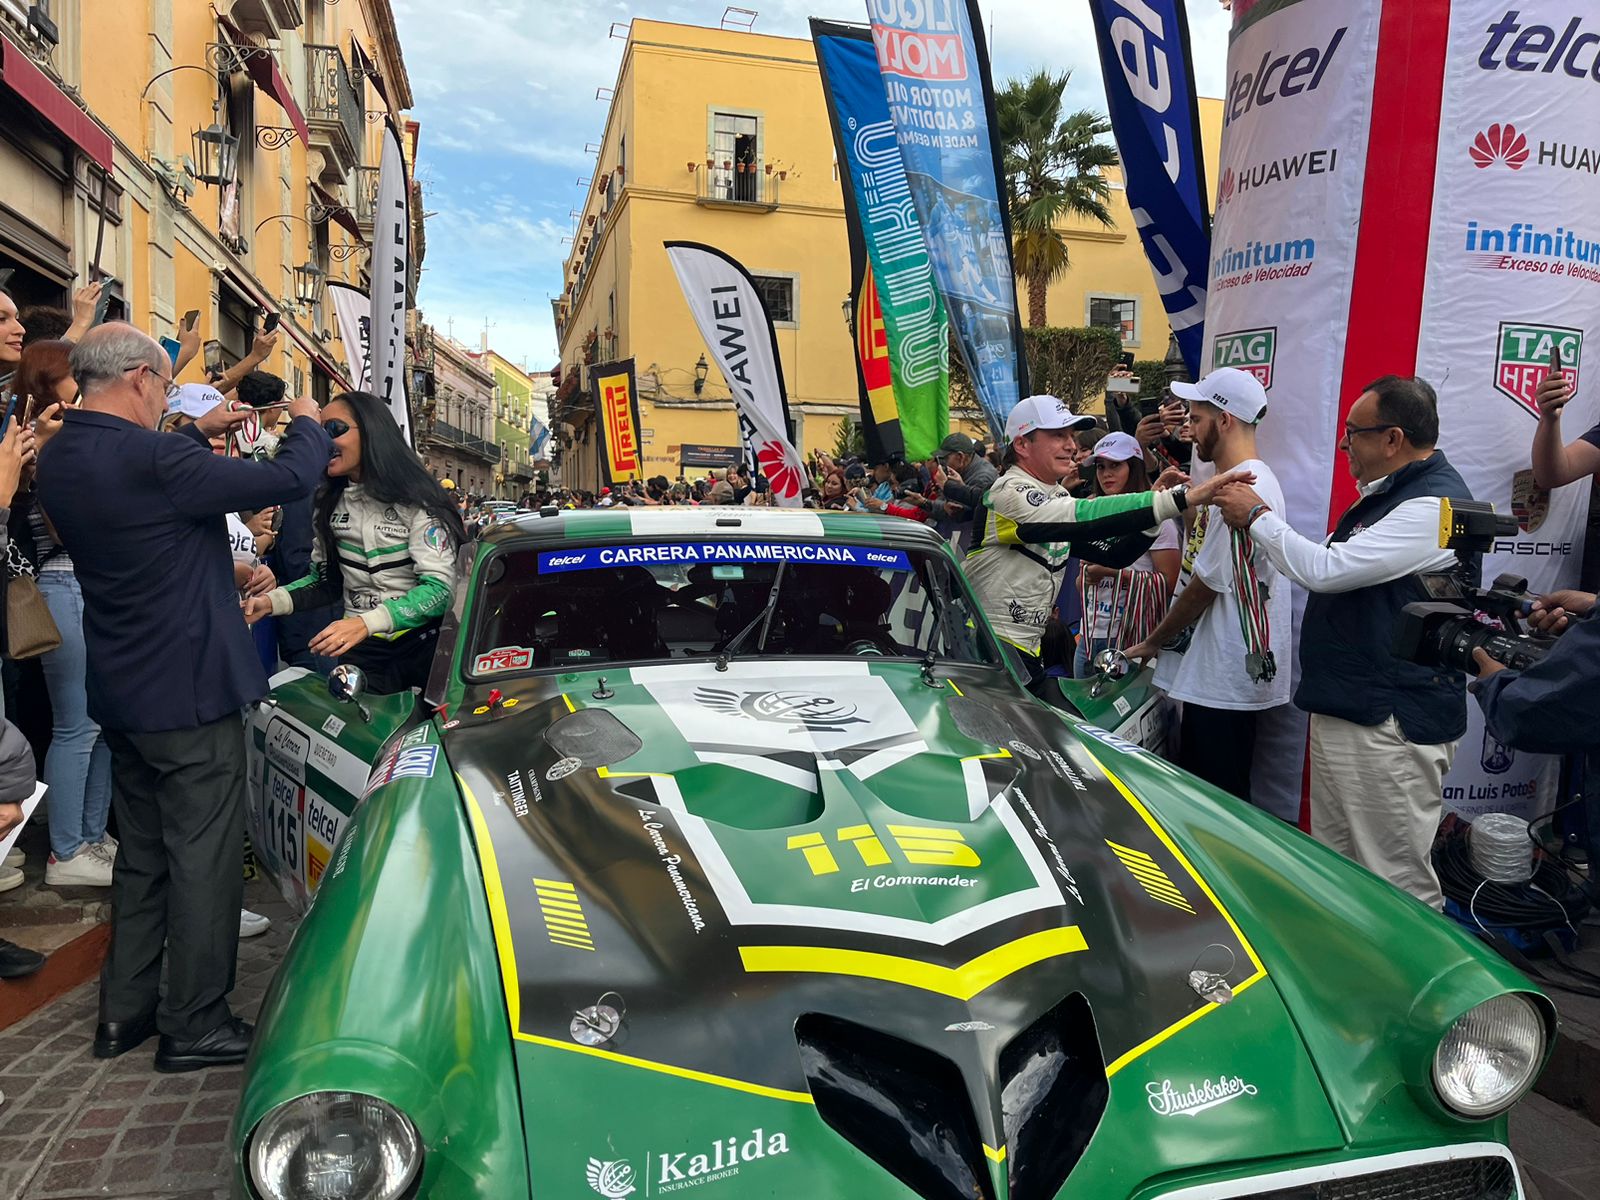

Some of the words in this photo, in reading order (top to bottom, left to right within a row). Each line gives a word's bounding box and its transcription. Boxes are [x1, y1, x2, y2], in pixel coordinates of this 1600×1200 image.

[1478, 10, 1600, 83] telc
[1225, 26, 1348, 128] telcel
[1238, 148, 1338, 193] HUAWEI
[1240, 269, 1254, 285] de
[1253, 262, 1313, 283] Velocidad
[1499, 255, 1549, 273] Exceso
[1550, 260, 1565, 275] de
[1216, 335, 1267, 365] TAG
[1510, 331, 1576, 364] TAG
[605, 385, 637, 472] PIRELLI
[548, 554, 587, 567] telcel
[599, 546, 700, 564] CARRERA
[702, 545, 857, 563] PANAMERICANA
[866, 552, 898, 563] telcel
[1493, 541, 1572, 556] RSCHE
[479, 657, 507, 671] OK
[272, 772, 296, 809] telcel
[507, 769, 529, 818] TAITTINGER
[1442, 787, 1465, 800] an
[1468, 783, 1498, 800] Luis
[307, 798, 339, 845] telcel
[638, 809, 657, 821] La
[268, 799, 298, 871] 115
[643, 822, 670, 856] Carrera
[786, 823, 982, 877] 115
[850, 877, 871, 894] El
[873, 874, 979, 889] Commander
[1145, 1075, 1258, 1116] Studebaker
[658, 1127, 790, 1185] Kalida
[658, 1176, 706, 1195] INSURANCE
[706, 1166, 740, 1184] BROKER
